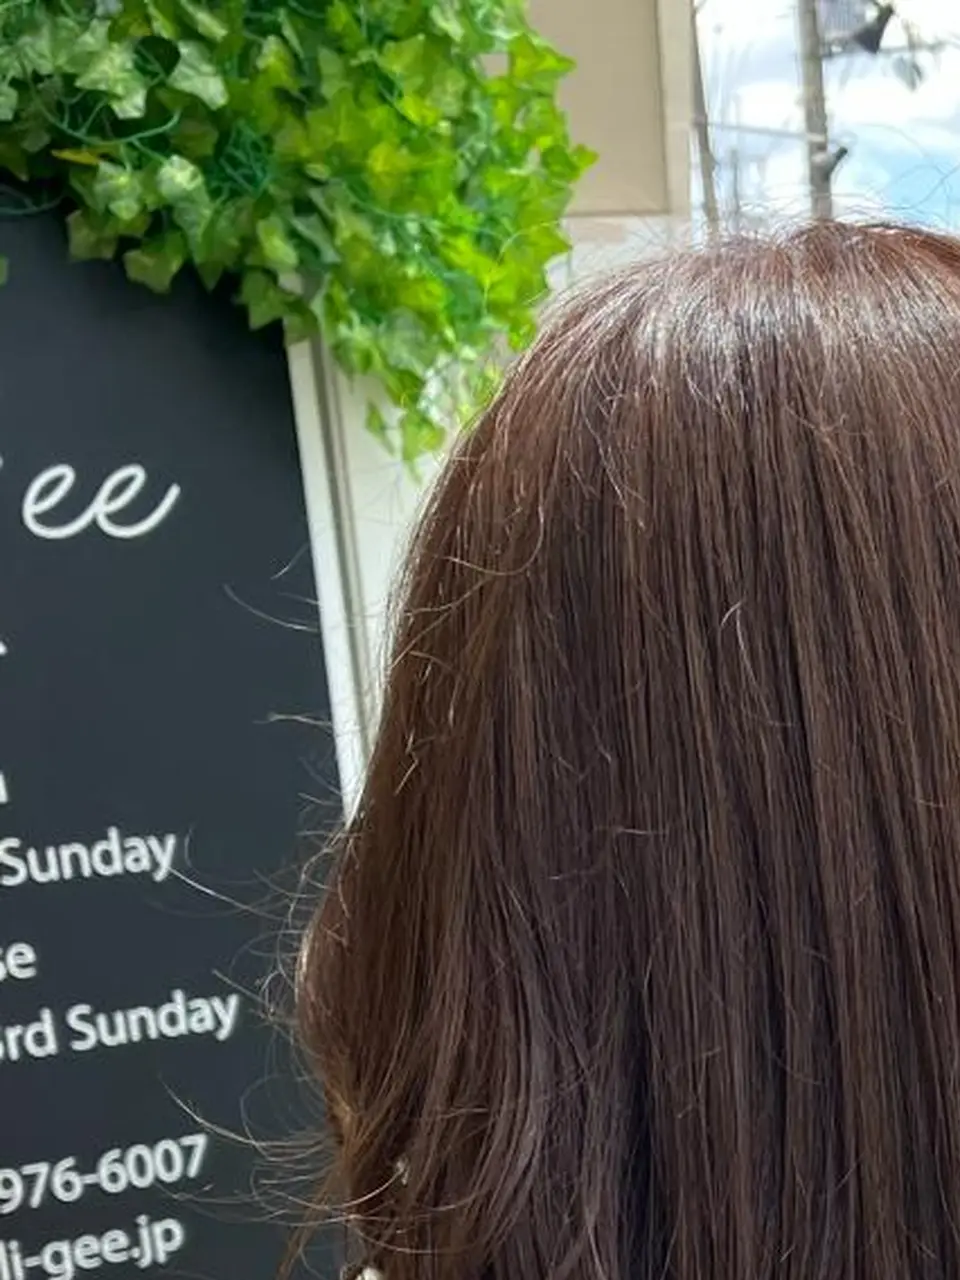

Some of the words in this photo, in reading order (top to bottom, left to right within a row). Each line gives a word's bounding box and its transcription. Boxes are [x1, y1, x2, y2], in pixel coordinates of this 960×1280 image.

[0, 827, 177, 887] Sunday
[0, 1007, 58, 1061] rd
[66, 988, 240, 1052] Sunday
[0, 1133, 208, 1214] 976-6007
